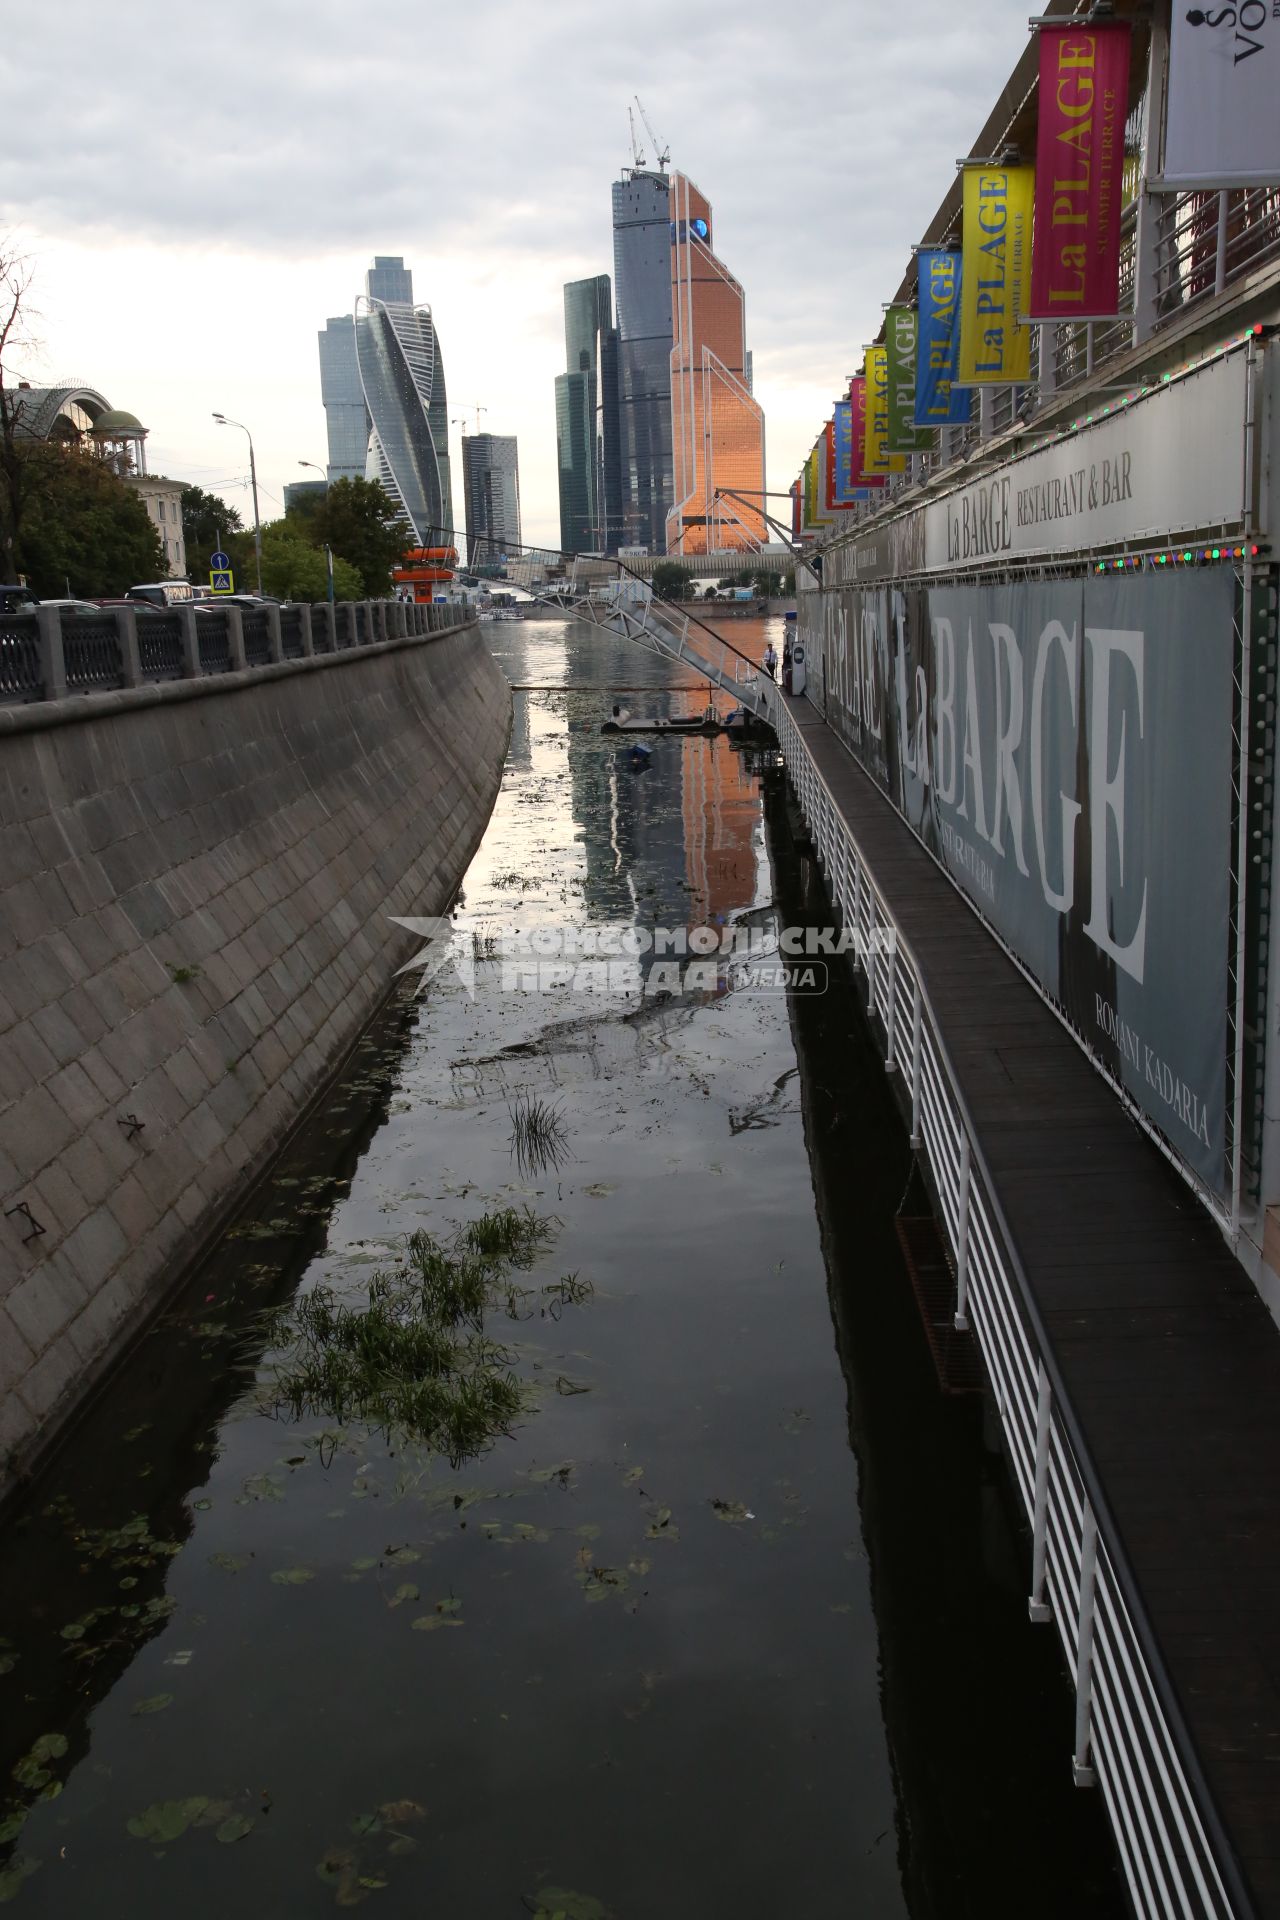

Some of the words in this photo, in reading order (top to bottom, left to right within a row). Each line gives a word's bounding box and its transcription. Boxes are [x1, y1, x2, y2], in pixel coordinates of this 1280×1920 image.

[1052, 36, 1096, 229] PLAGE
[1101, 88, 1115, 172] TERRACE
[976, 174, 1008, 320] PLAGE
[1013, 211, 1023, 272] TERRACE
[1098, 179, 1112, 255] SUMMER
[929, 257, 954, 369] PLAGE
[1049, 242, 1087, 305] La
[895, 313, 915, 408] PLAGE
[927, 379, 951, 416] La
[975, 327, 1004, 375] La
[947, 504, 960, 562] La
[962, 476, 1012, 559] BARGE
[1017, 469, 1085, 527] RESTAURANT
[1088, 464, 1098, 511] &
[1101, 452, 1133, 506] BAR
[897, 616, 930, 786] La
[935, 616, 1147, 985] BARGE
[1095, 992, 1140, 1072] ROMANI
[1144, 1044, 1211, 1149] KADARIA
